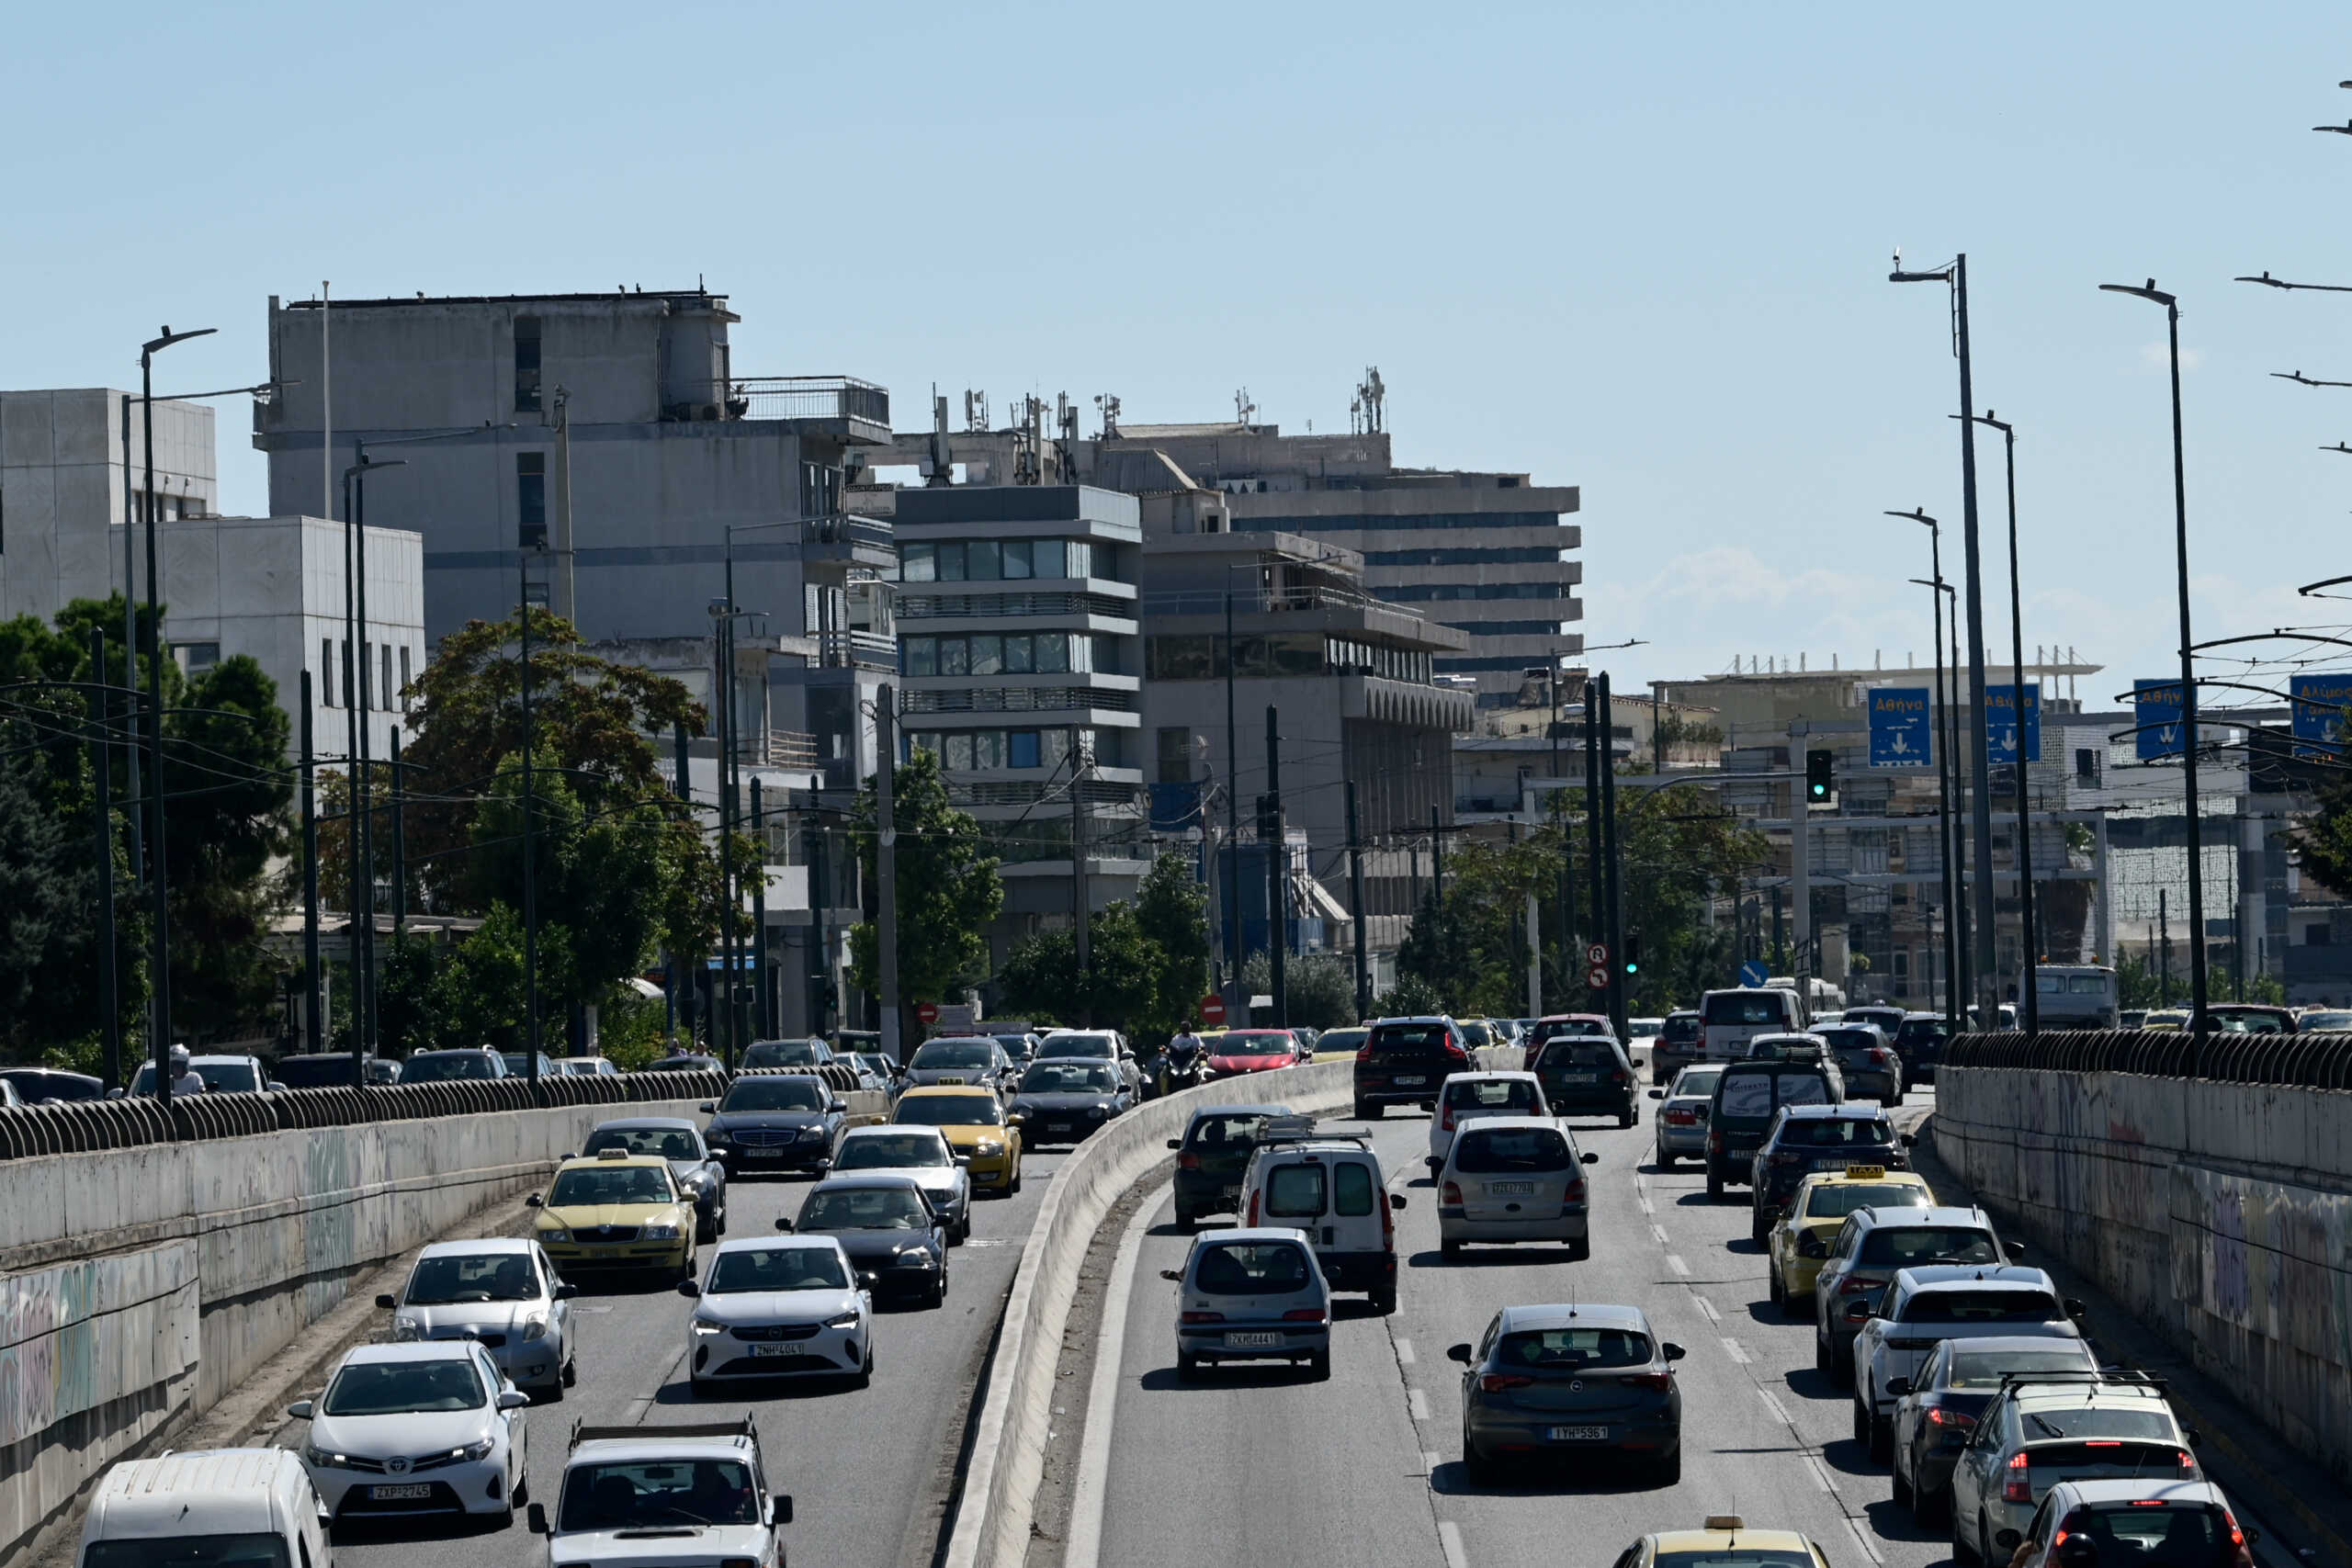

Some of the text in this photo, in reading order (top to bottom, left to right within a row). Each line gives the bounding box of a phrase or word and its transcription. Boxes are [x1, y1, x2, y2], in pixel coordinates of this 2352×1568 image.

[1875, 696, 1924, 713] Αθήνα
[1985, 694, 2032, 710] Αθήα
[2142, 688, 2182, 705] Αθήν
